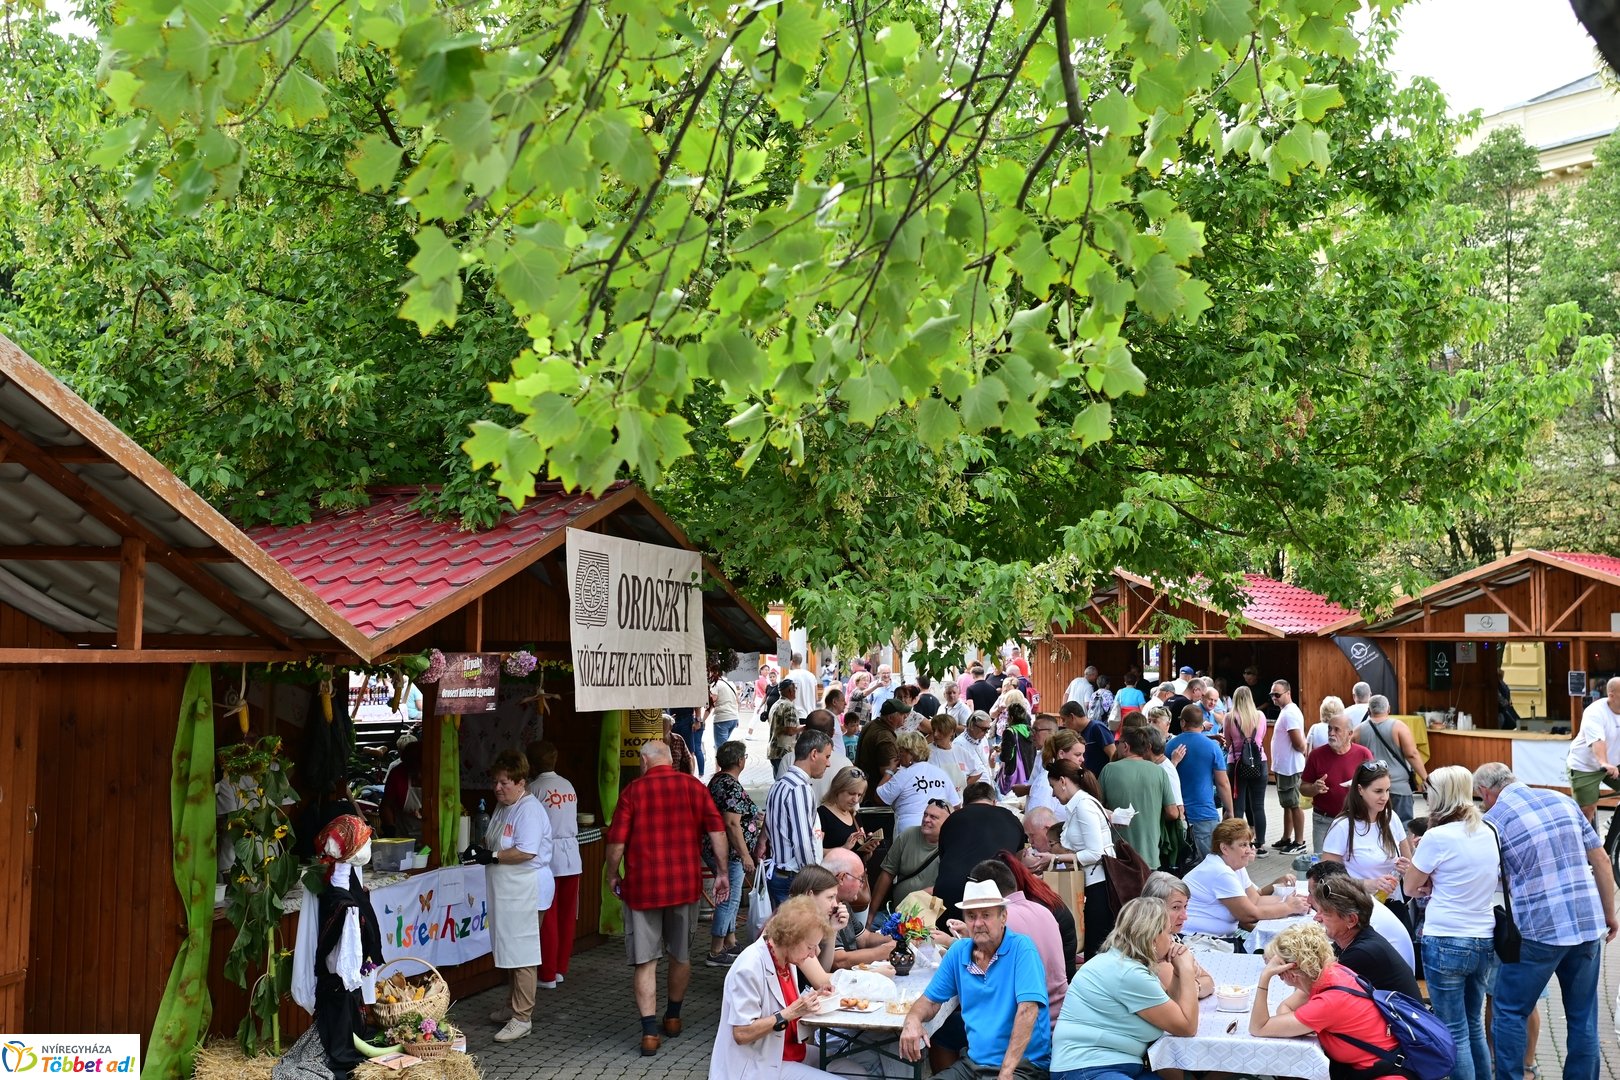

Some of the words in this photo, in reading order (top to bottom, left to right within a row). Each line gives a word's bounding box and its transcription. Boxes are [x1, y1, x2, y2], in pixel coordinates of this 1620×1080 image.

[617, 568, 693, 633] OROSÉRT
[577, 643, 626, 687] KÖZÉLETI
[628, 648, 692, 687] EGYESÜLET
